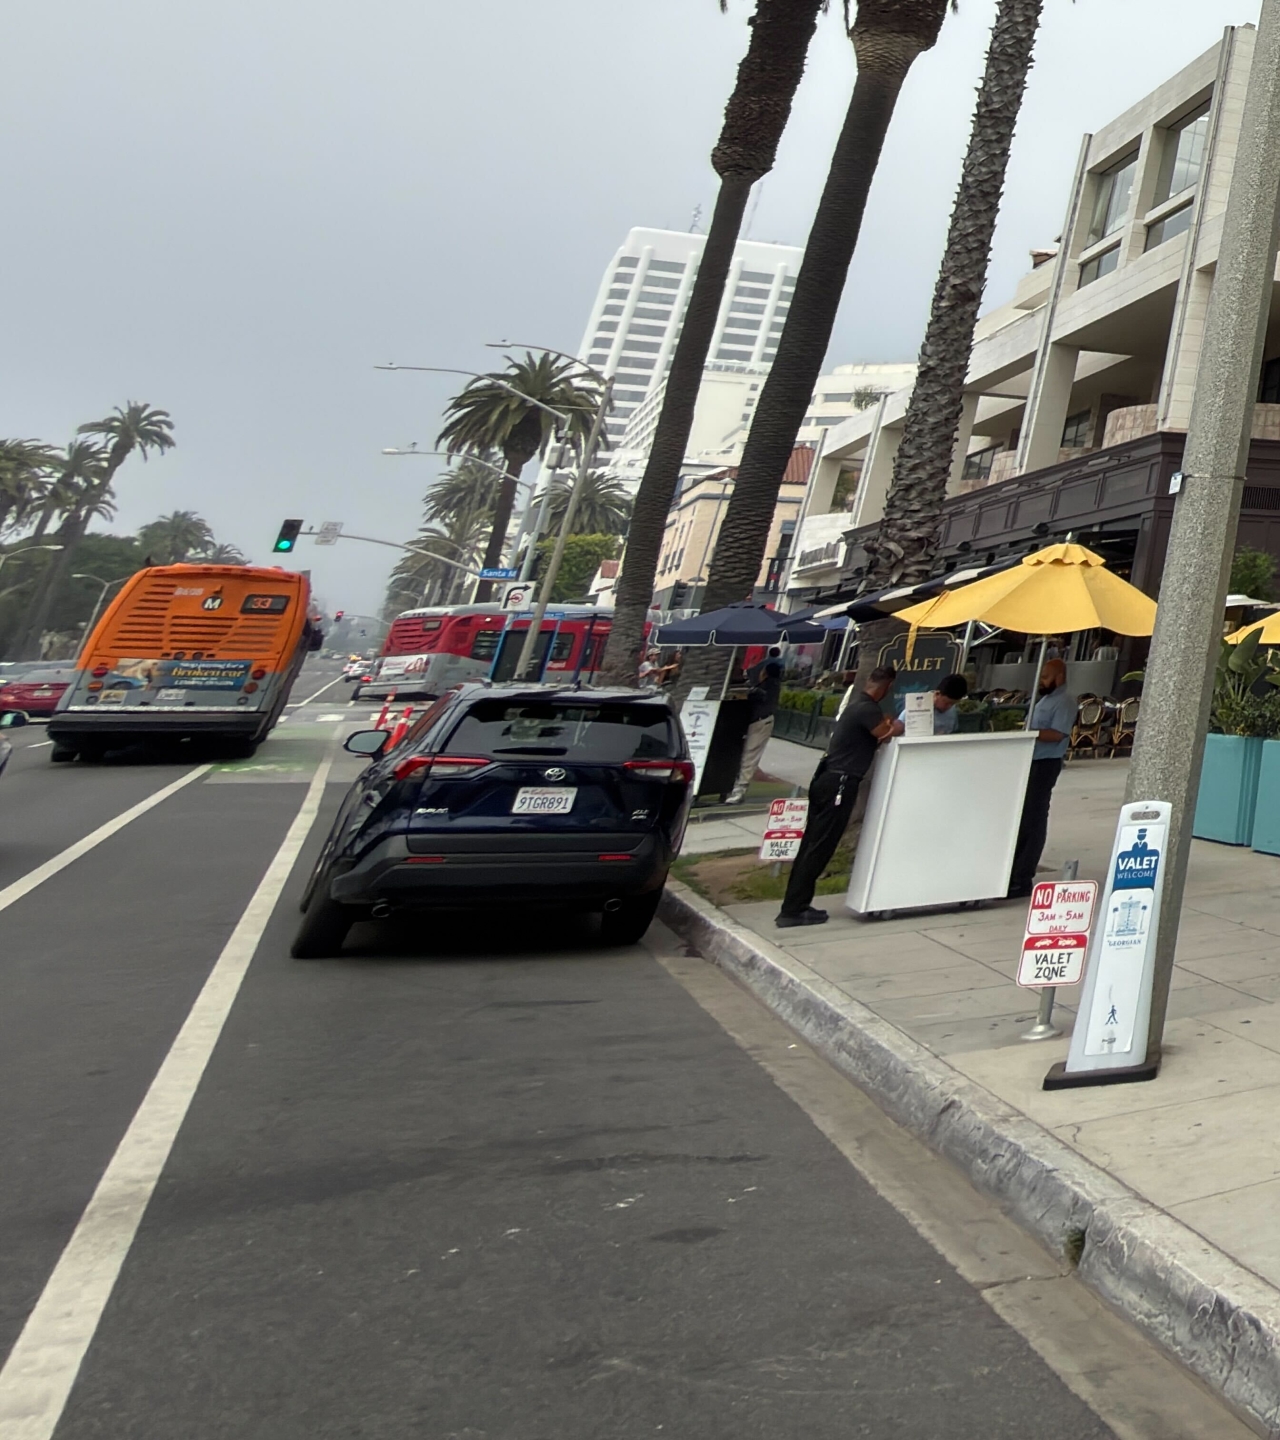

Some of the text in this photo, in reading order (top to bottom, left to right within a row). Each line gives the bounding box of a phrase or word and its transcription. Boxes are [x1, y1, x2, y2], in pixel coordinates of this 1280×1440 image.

[482, 568, 506, 577] Santa
[251, 597, 272, 608] 33
[892, 657, 945, 671] VALET
[517, 796, 569, 810] 9TGR891
[772, 802, 785, 815] NO
[770, 840, 794, 848] VALET
[769, 848, 790, 856] ZONE
[1118, 856, 1158, 870] VALET
[1117, 870, 1155, 880] WELCOME
[1034, 888, 1090, 906] NO PARKING
[1038, 912, 1056, 922] 3AM
[1065, 910, 1084, 920] 5AM
[1034, 952, 1074, 965] VALET
[1034, 966, 1067, 979] ZONE
